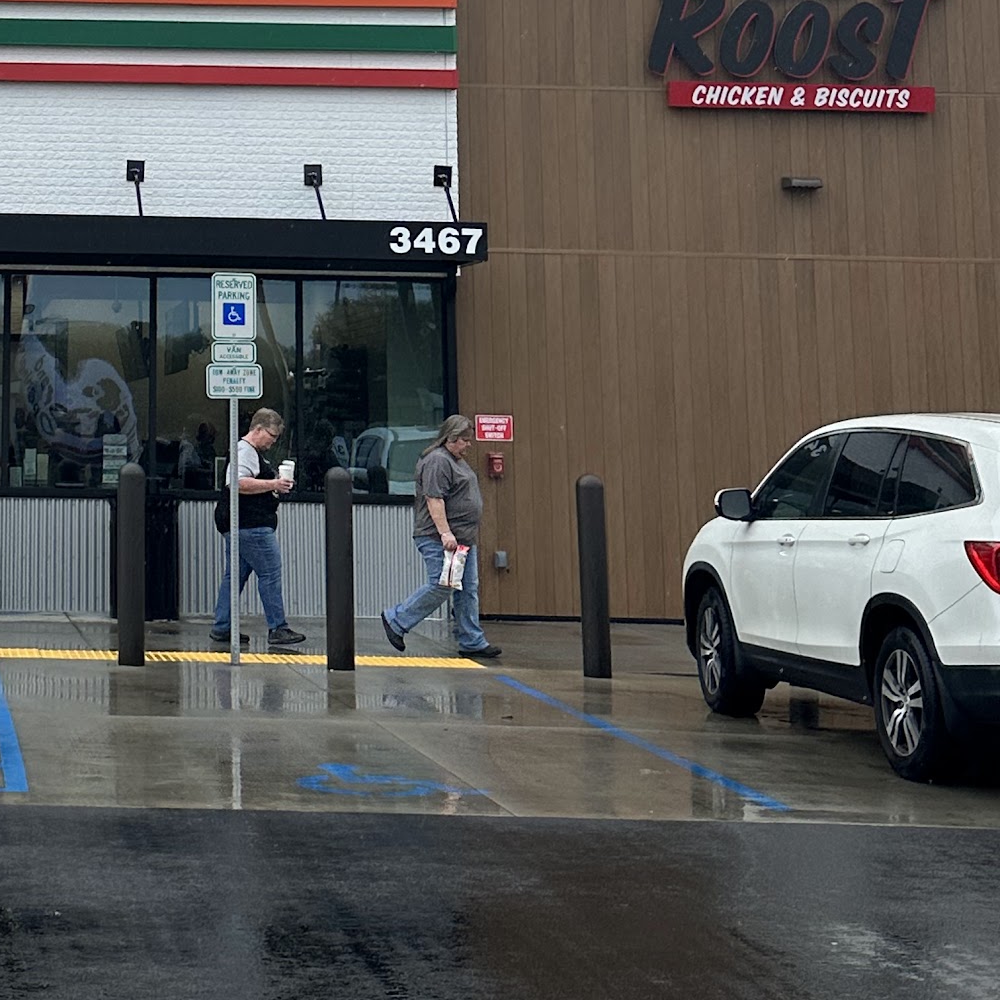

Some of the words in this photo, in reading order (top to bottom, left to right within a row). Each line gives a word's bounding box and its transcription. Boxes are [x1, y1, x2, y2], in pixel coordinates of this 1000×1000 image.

[691, 85, 784, 106] CHICKEN
[790, 87, 806, 107] &
[814, 87, 911, 109] BISCUITS
[389, 226, 482, 255] 3467
[216, 279, 253, 289] RESERVED
[218, 291, 250, 300] PARKING
[222, 377, 246, 385] PENALTY
